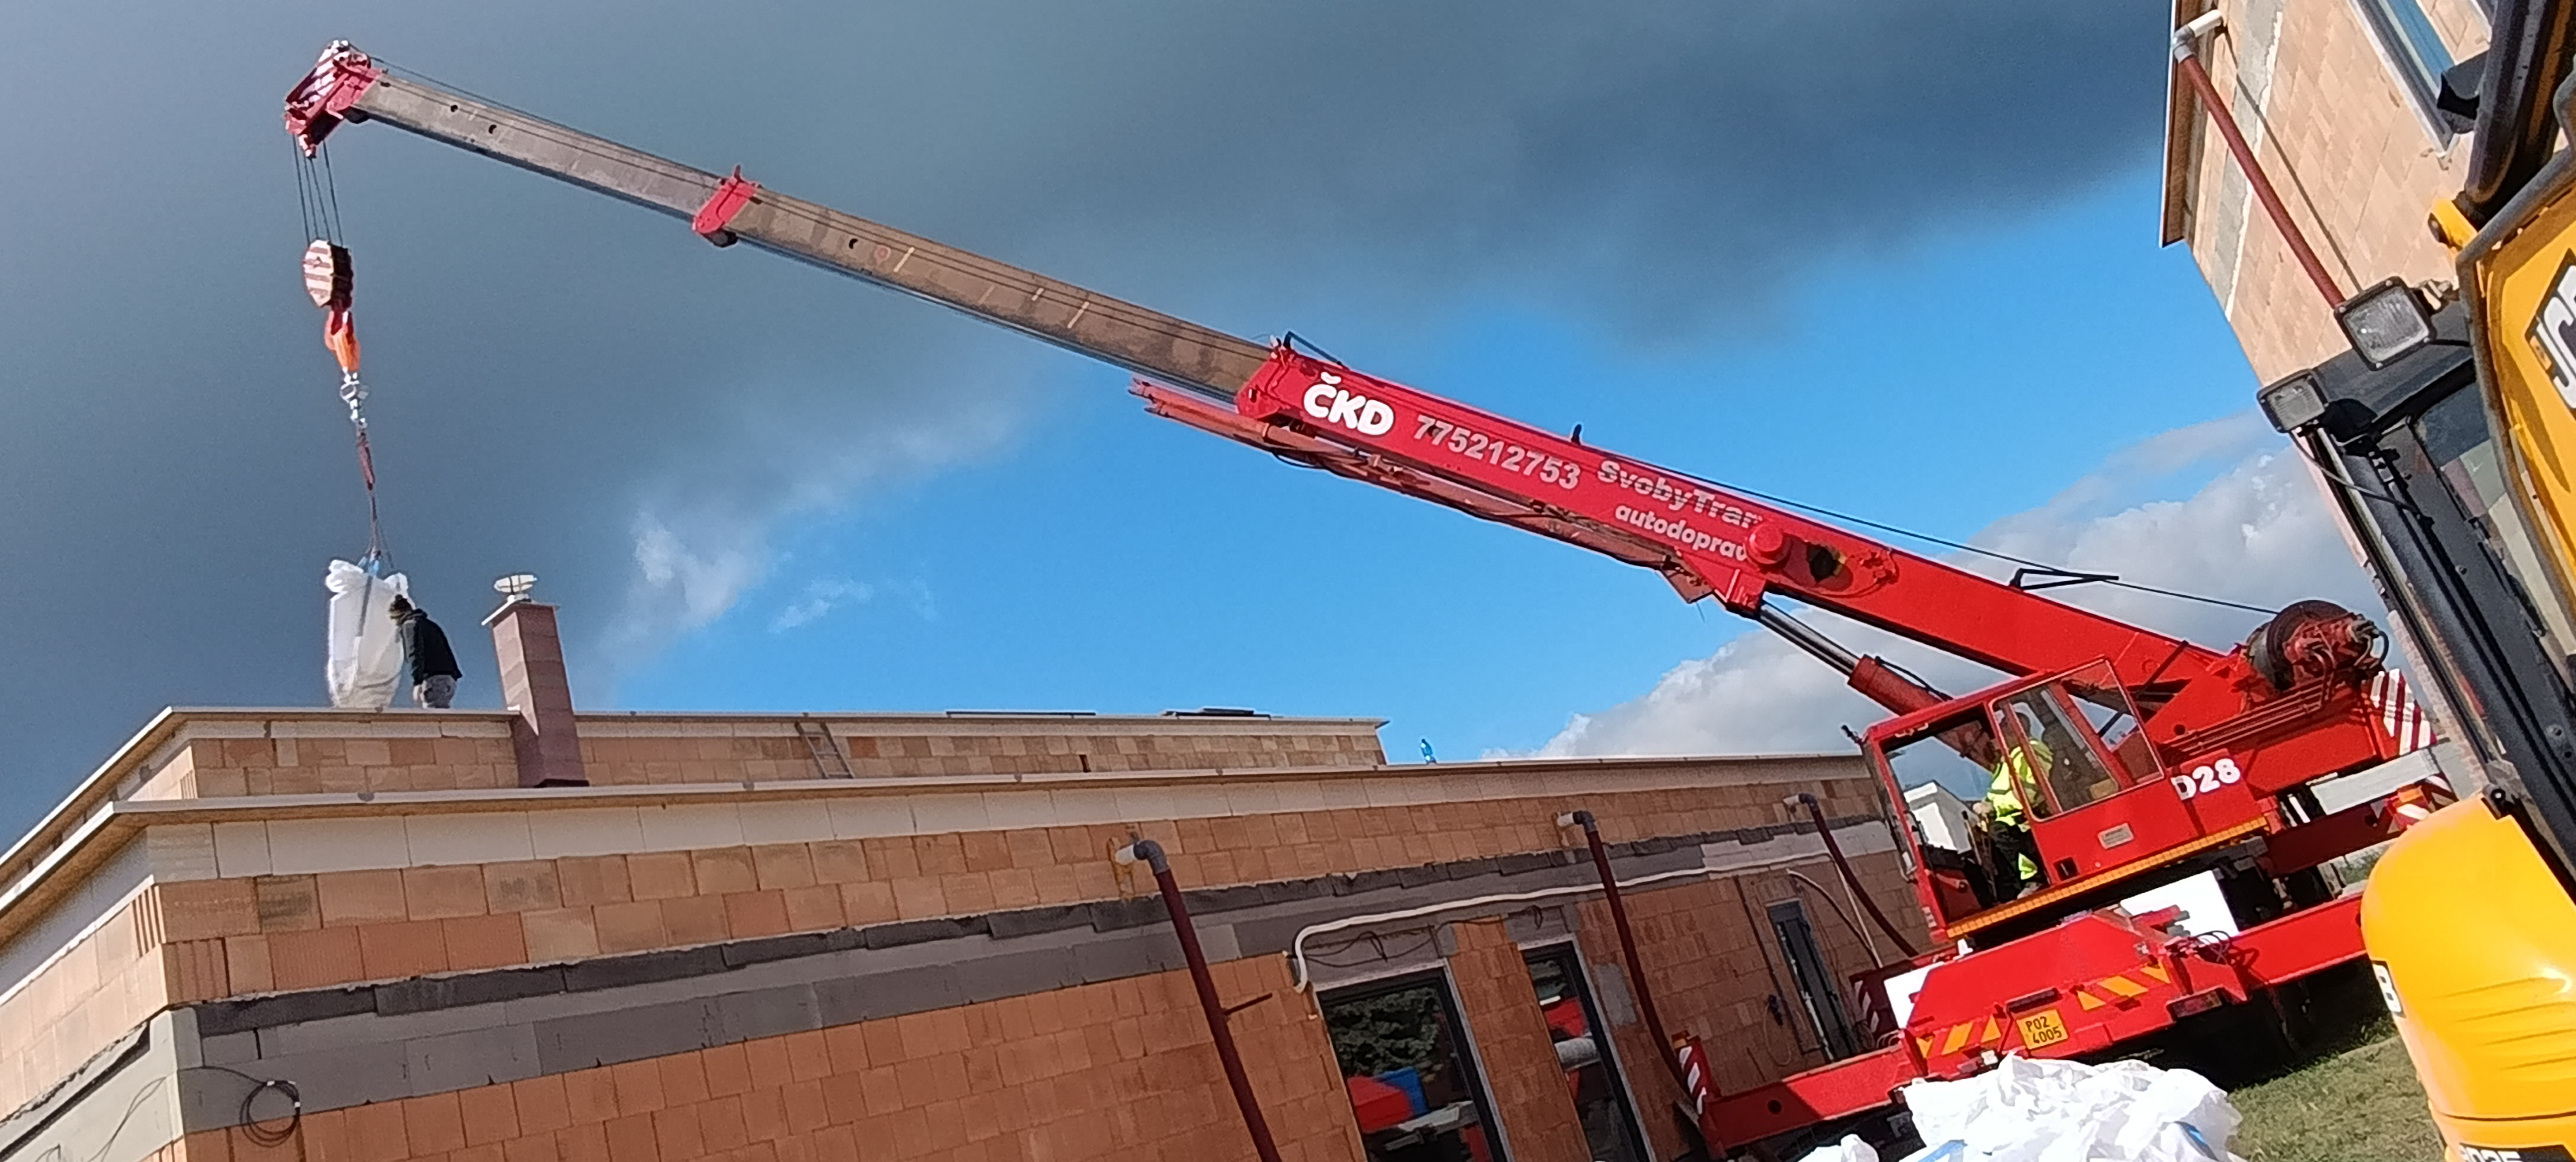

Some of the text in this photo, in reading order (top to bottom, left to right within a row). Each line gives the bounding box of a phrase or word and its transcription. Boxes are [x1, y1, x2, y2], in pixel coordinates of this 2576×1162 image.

[1304, 372, 1395, 436] ČKD
[1413, 415, 1581, 489] 775212753
[1597, 460, 1763, 529] SvobyTran
[1615, 505, 1748, 561] autodoprav
[2032, 1026, 2062, 1044] 4005
